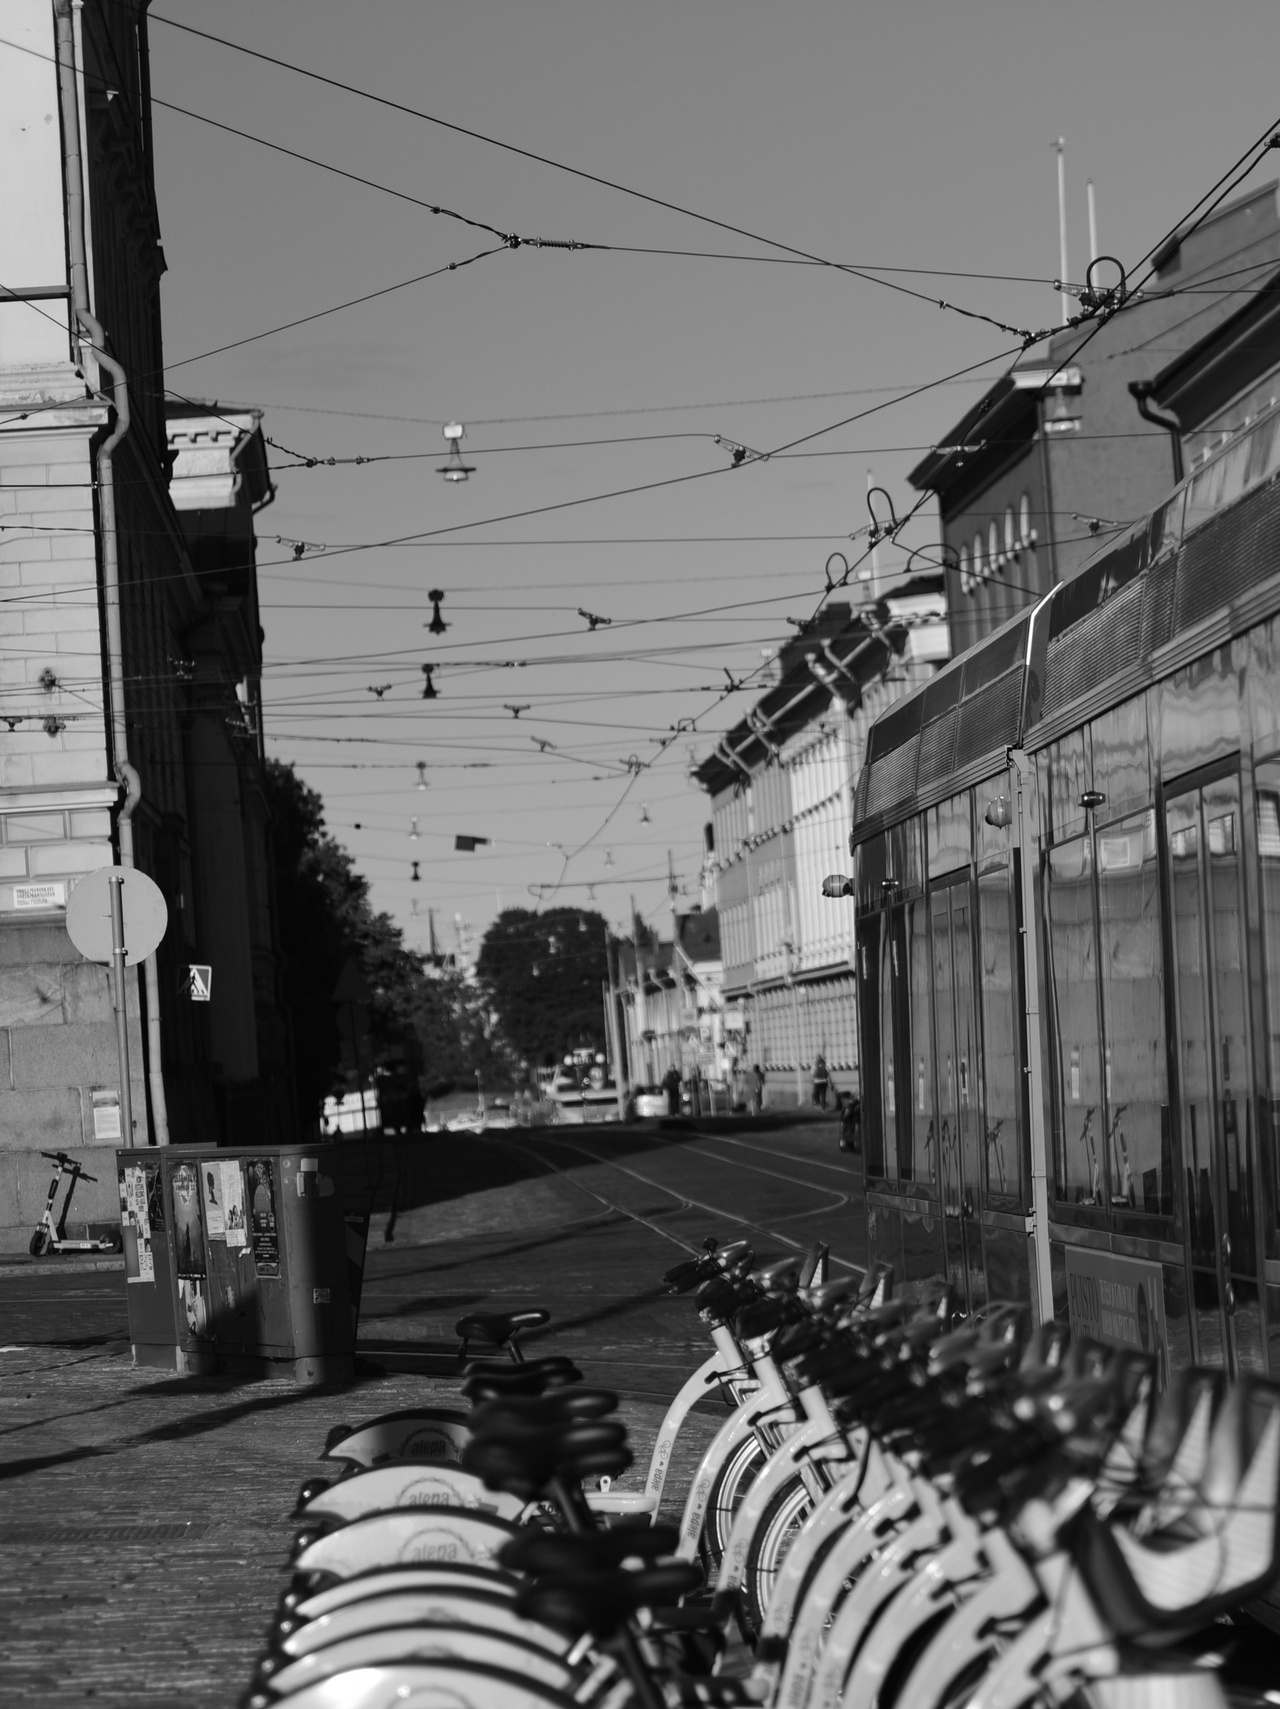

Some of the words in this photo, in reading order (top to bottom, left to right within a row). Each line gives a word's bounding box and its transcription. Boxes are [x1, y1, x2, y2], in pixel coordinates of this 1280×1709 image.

[1069, 1273, 1099, 1322] PUISTO
[412, 1440, 446, 1456] alepa
[651, 1468, 663, 1491] alepa
[687, 1512, 701, 1540] alepa
